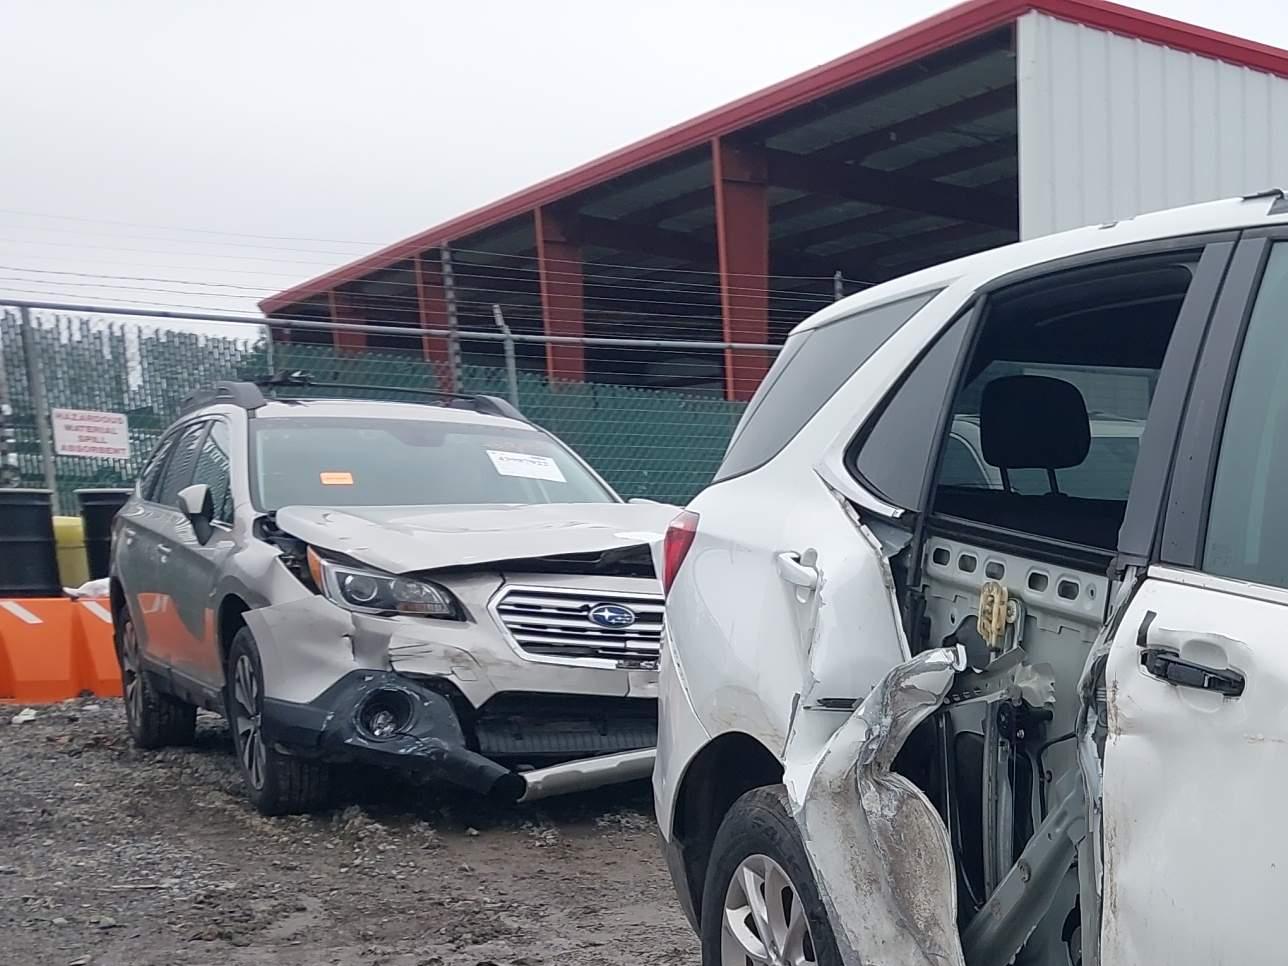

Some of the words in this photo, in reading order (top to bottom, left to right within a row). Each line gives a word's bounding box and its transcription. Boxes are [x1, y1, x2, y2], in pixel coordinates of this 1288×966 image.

[55, 412, 124, 425] HAZARDOUS
[63, 423, 119, 435] MATERIAL
[77, 434, 109, 445] SPILL
[60, 444, 128, 455] ABSORBENT
